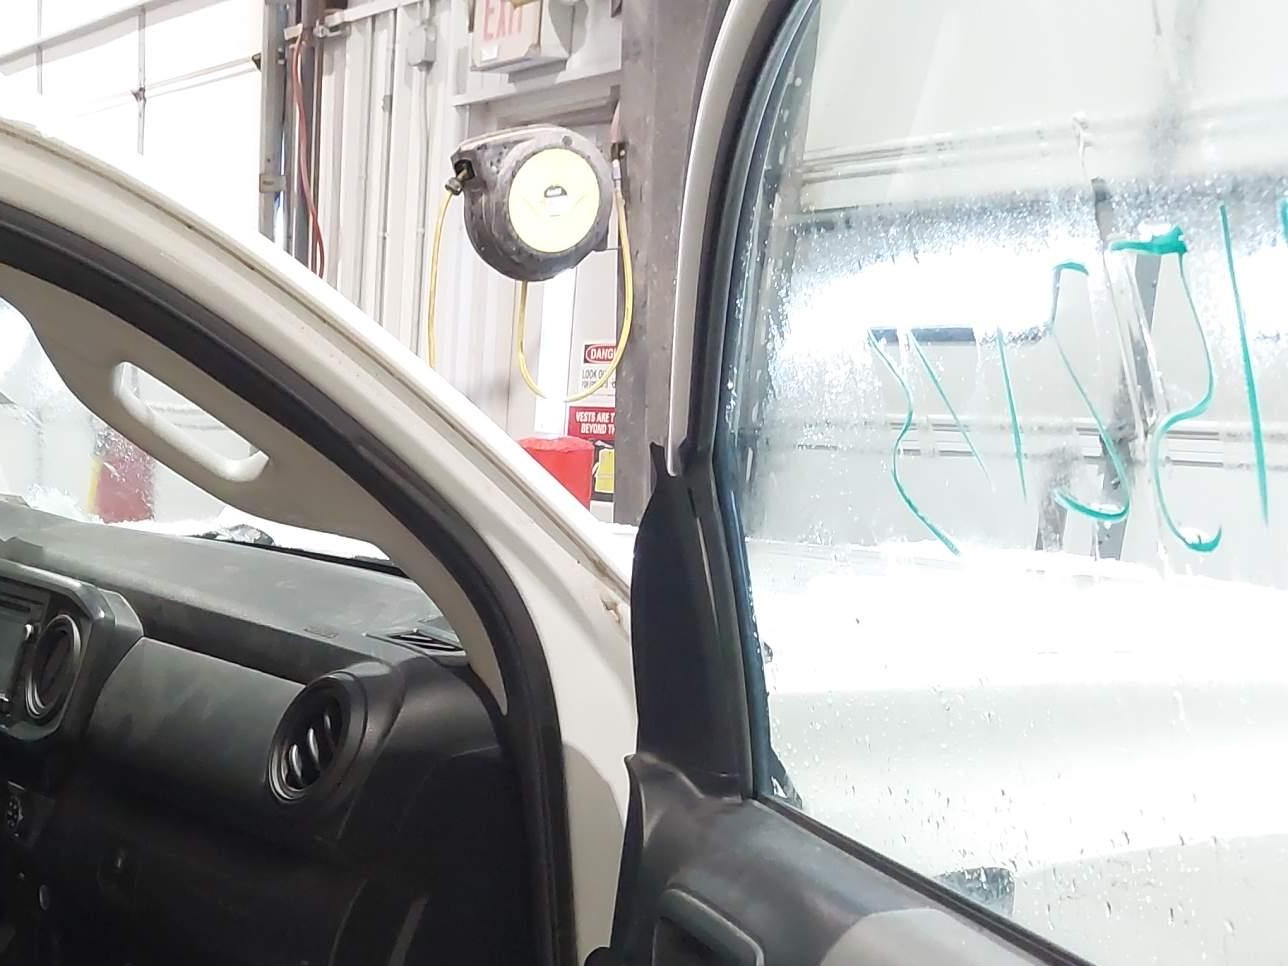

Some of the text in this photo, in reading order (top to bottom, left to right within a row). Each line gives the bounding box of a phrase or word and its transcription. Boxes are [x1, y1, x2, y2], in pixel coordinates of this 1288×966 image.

[590, 348, 616, 360] DANG
[575, 411, 595, 422] VESTS
[596, 412, 610, 423] ARE
[580, 423, 607, 434] BEYOND
